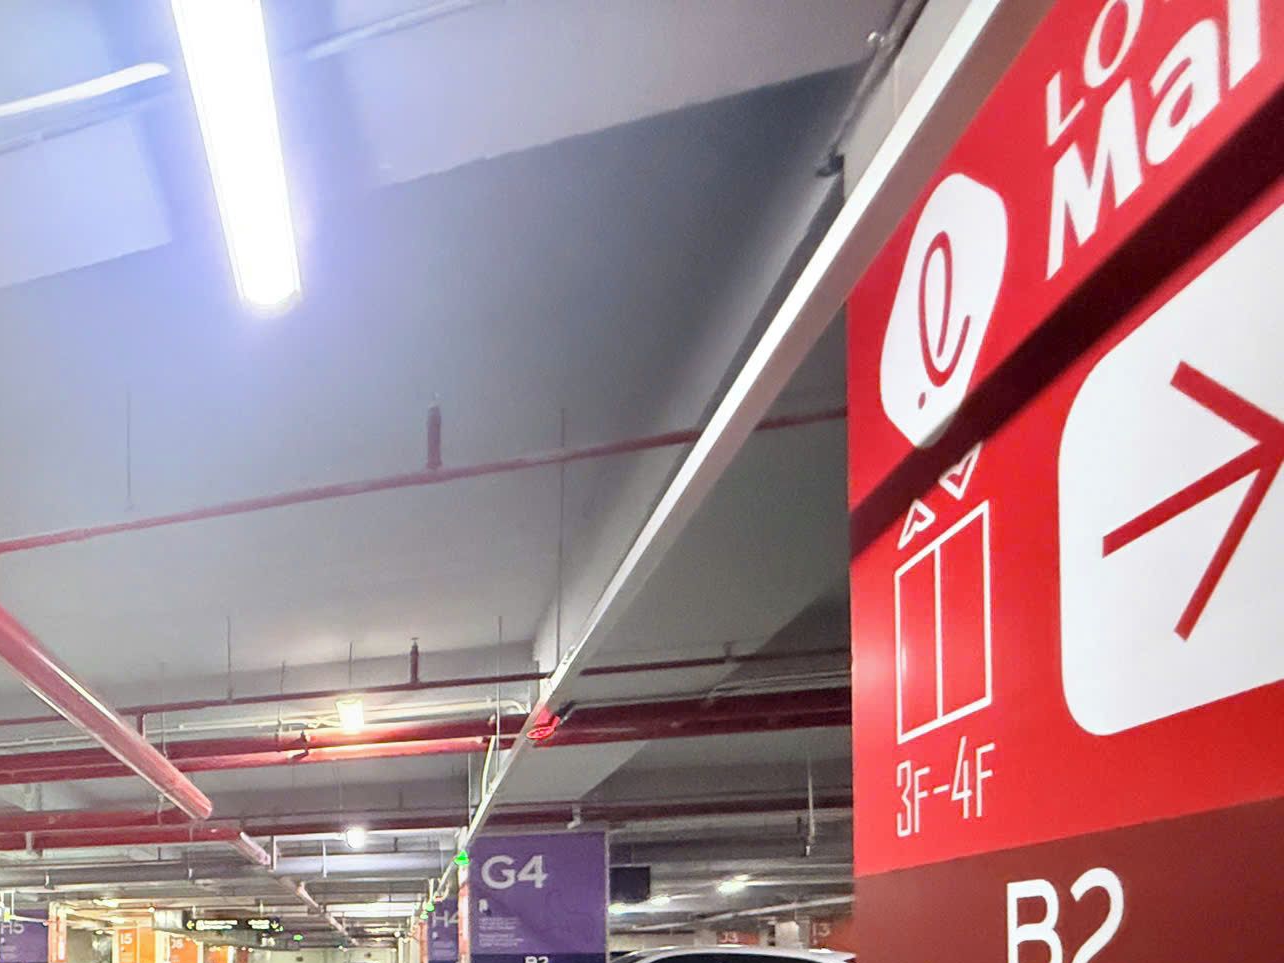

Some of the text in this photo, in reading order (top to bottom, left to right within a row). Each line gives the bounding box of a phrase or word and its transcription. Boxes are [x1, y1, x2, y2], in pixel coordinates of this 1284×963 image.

[1046, 0, 1146, 147] LO
[896, 736, 995, 837] 3F-4F
[481, 855, 548, 889] G4
